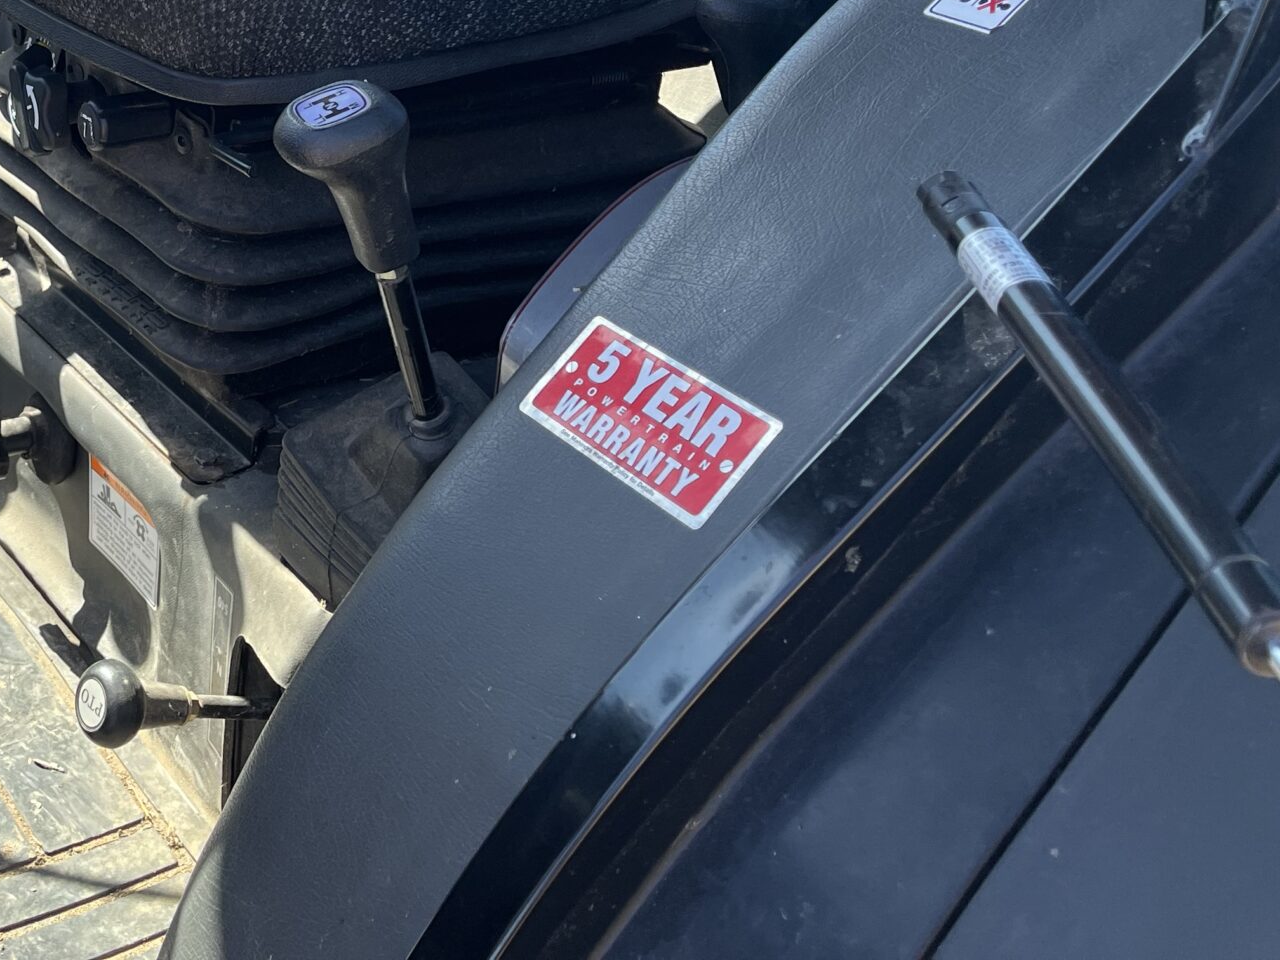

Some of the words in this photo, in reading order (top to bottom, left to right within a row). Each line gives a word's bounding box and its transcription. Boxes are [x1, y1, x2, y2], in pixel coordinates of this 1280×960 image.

[553, 390, 700, 497] WARRANTY
[573, 378, 711, 471] POWERTRAIN
[586, 340, 632, 384] 5
[623, 358, 743, 457] YEAR
[81, 688, 103, 717] PTO
